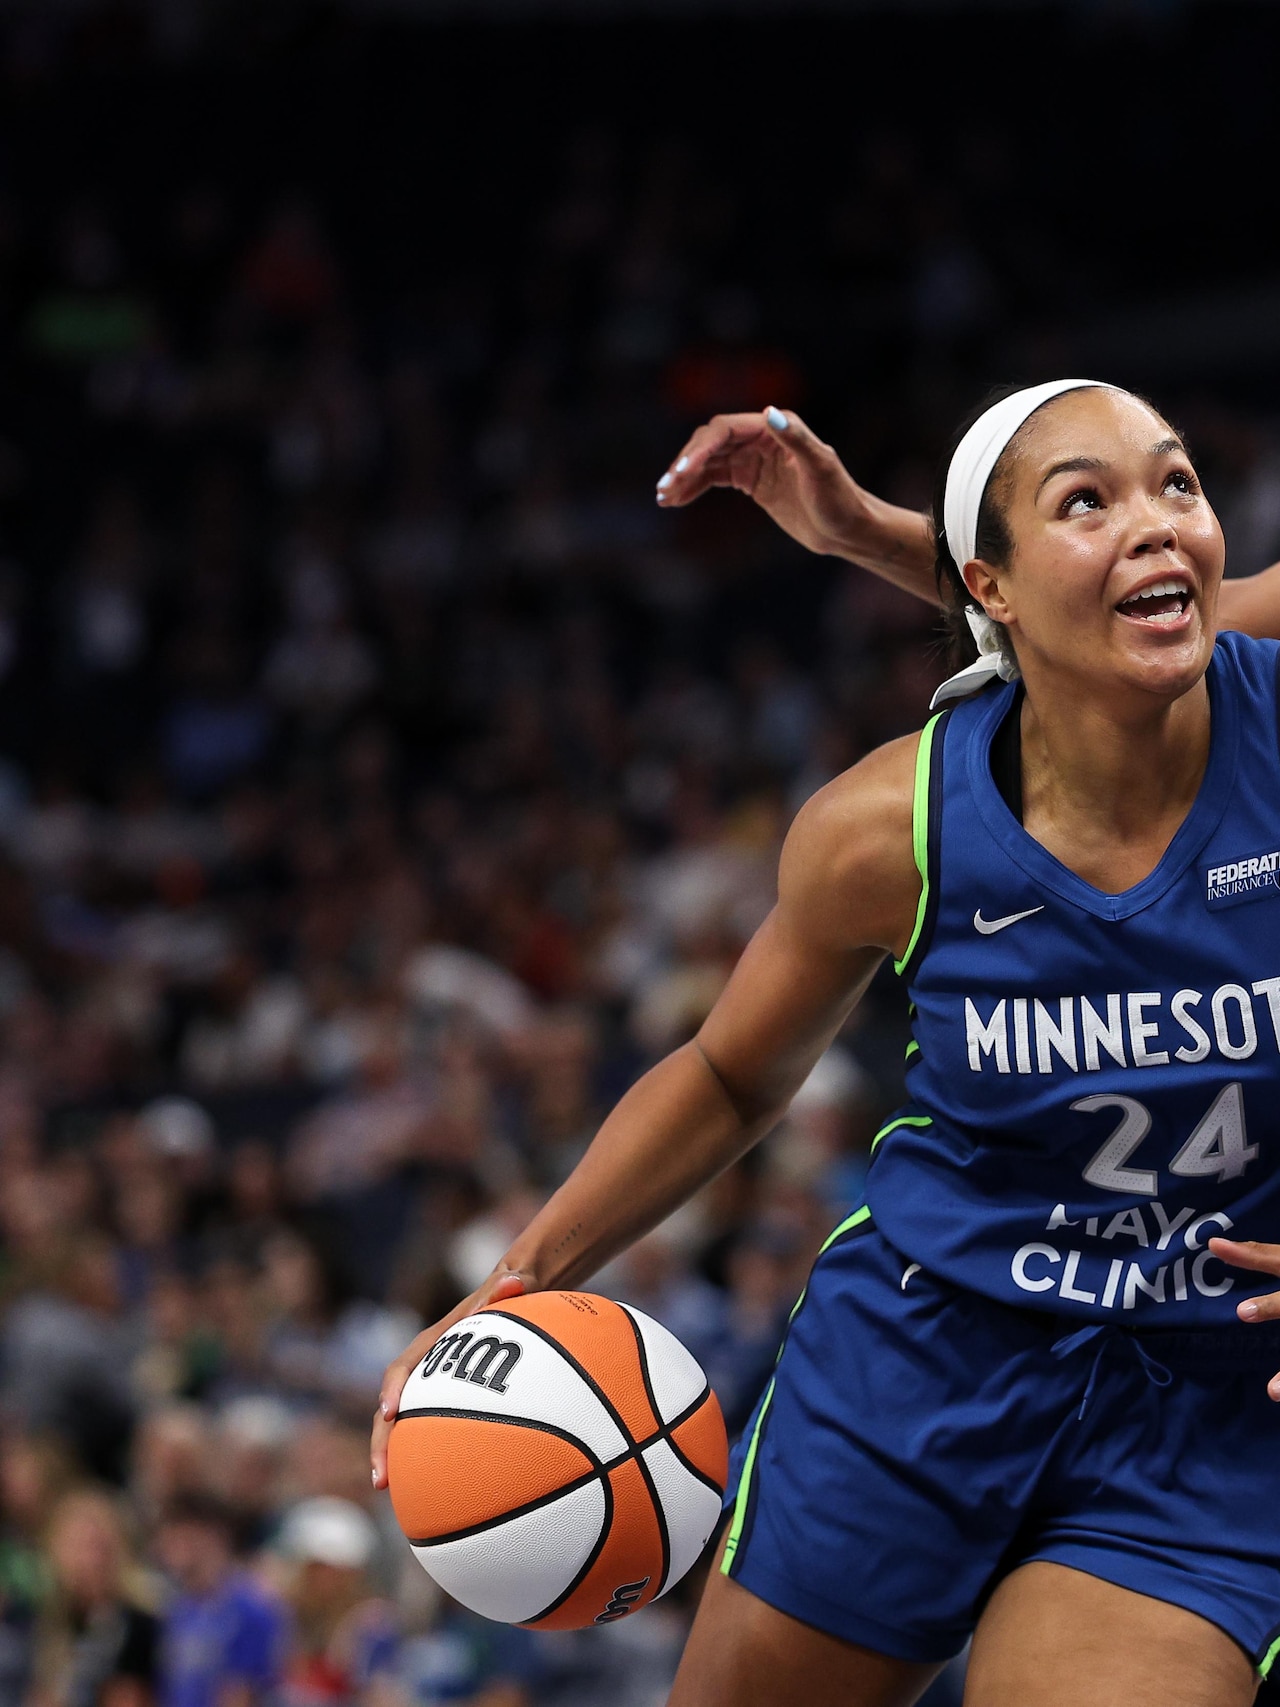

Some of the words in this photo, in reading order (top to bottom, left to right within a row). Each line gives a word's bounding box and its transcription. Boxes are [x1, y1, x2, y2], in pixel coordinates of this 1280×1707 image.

[1207, 872, 1274, 901] INSURANCE
[1069, 1081, 1260, 1197] 24
[1010, 1241, 1235, 1310] CLINIC
